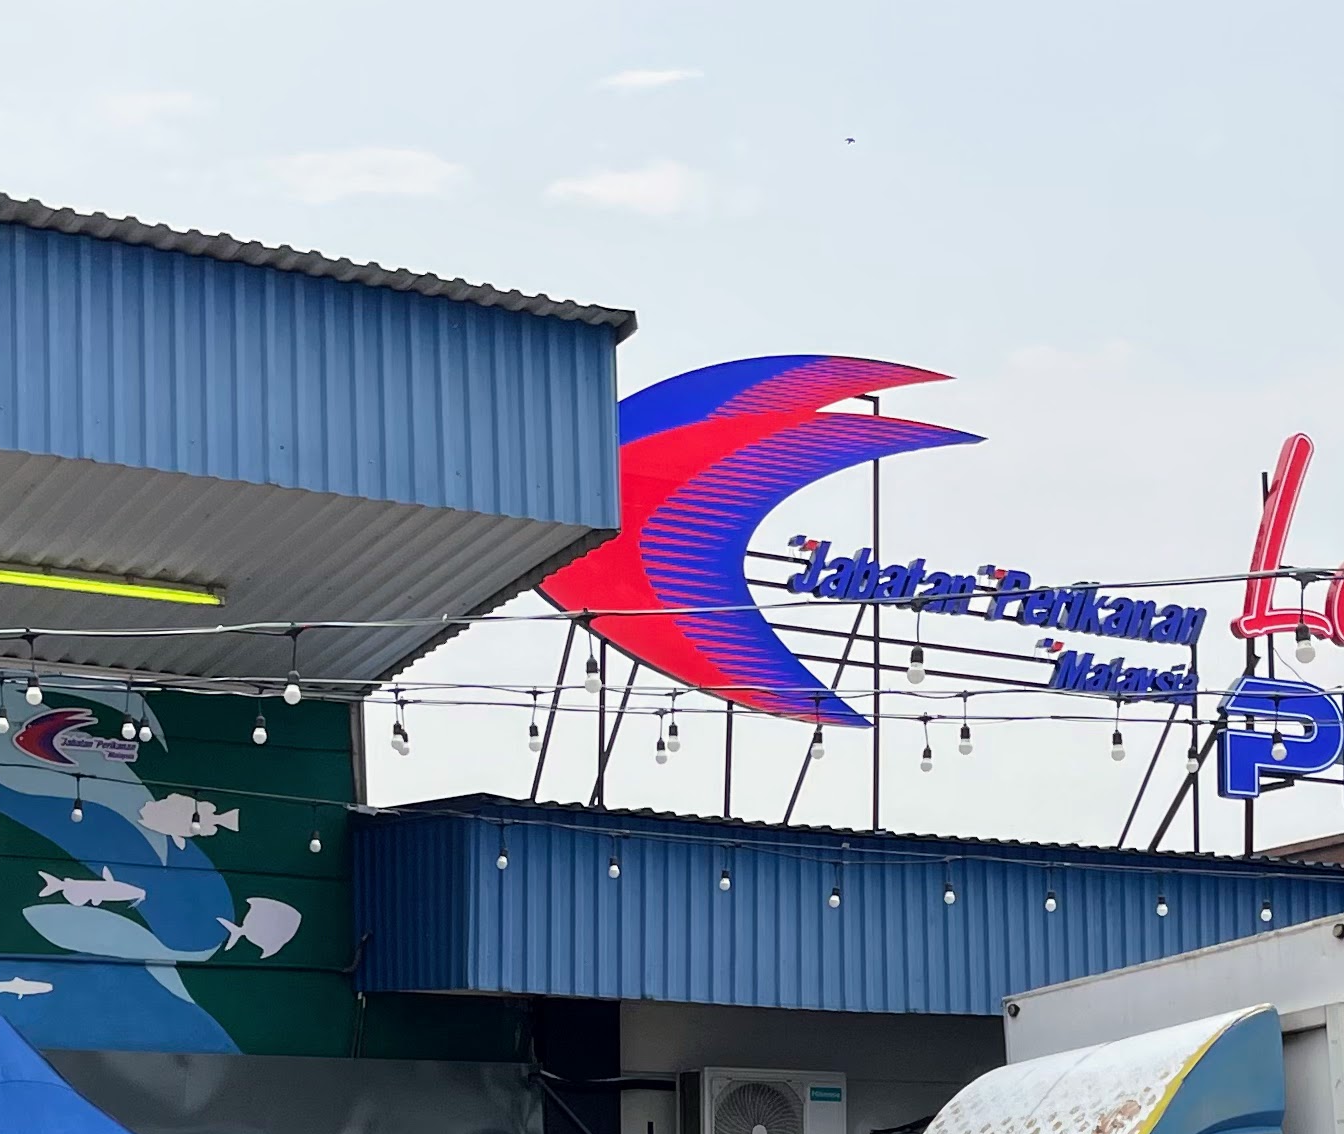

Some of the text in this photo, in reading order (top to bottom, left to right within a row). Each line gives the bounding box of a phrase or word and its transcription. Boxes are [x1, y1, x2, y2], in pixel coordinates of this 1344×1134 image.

[787, 539, 1207, 646] Jabatan Perikanan
[1050, 649, 1199, 704] Malaysia
